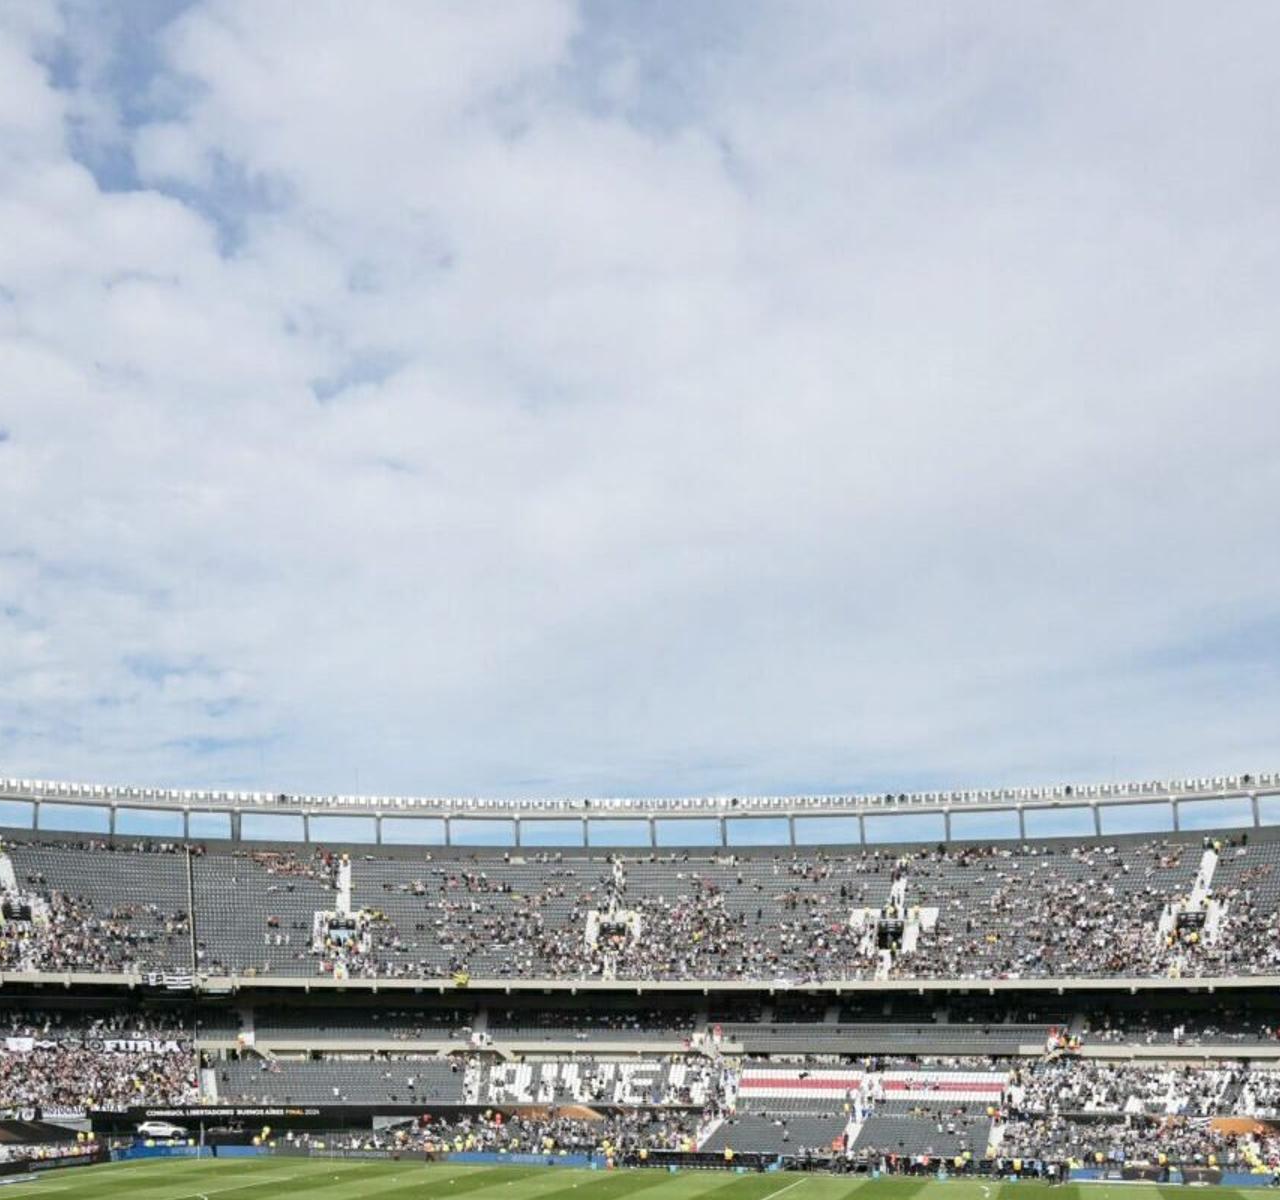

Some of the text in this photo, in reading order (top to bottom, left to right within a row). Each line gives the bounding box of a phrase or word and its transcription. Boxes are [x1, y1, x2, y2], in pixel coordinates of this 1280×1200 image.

[489, 1061, 714, 1104] RIVER
[146, 1109, 185, 1117] CONMEBOL
[186, 1109, 235, 1117] LIBERTADORES
